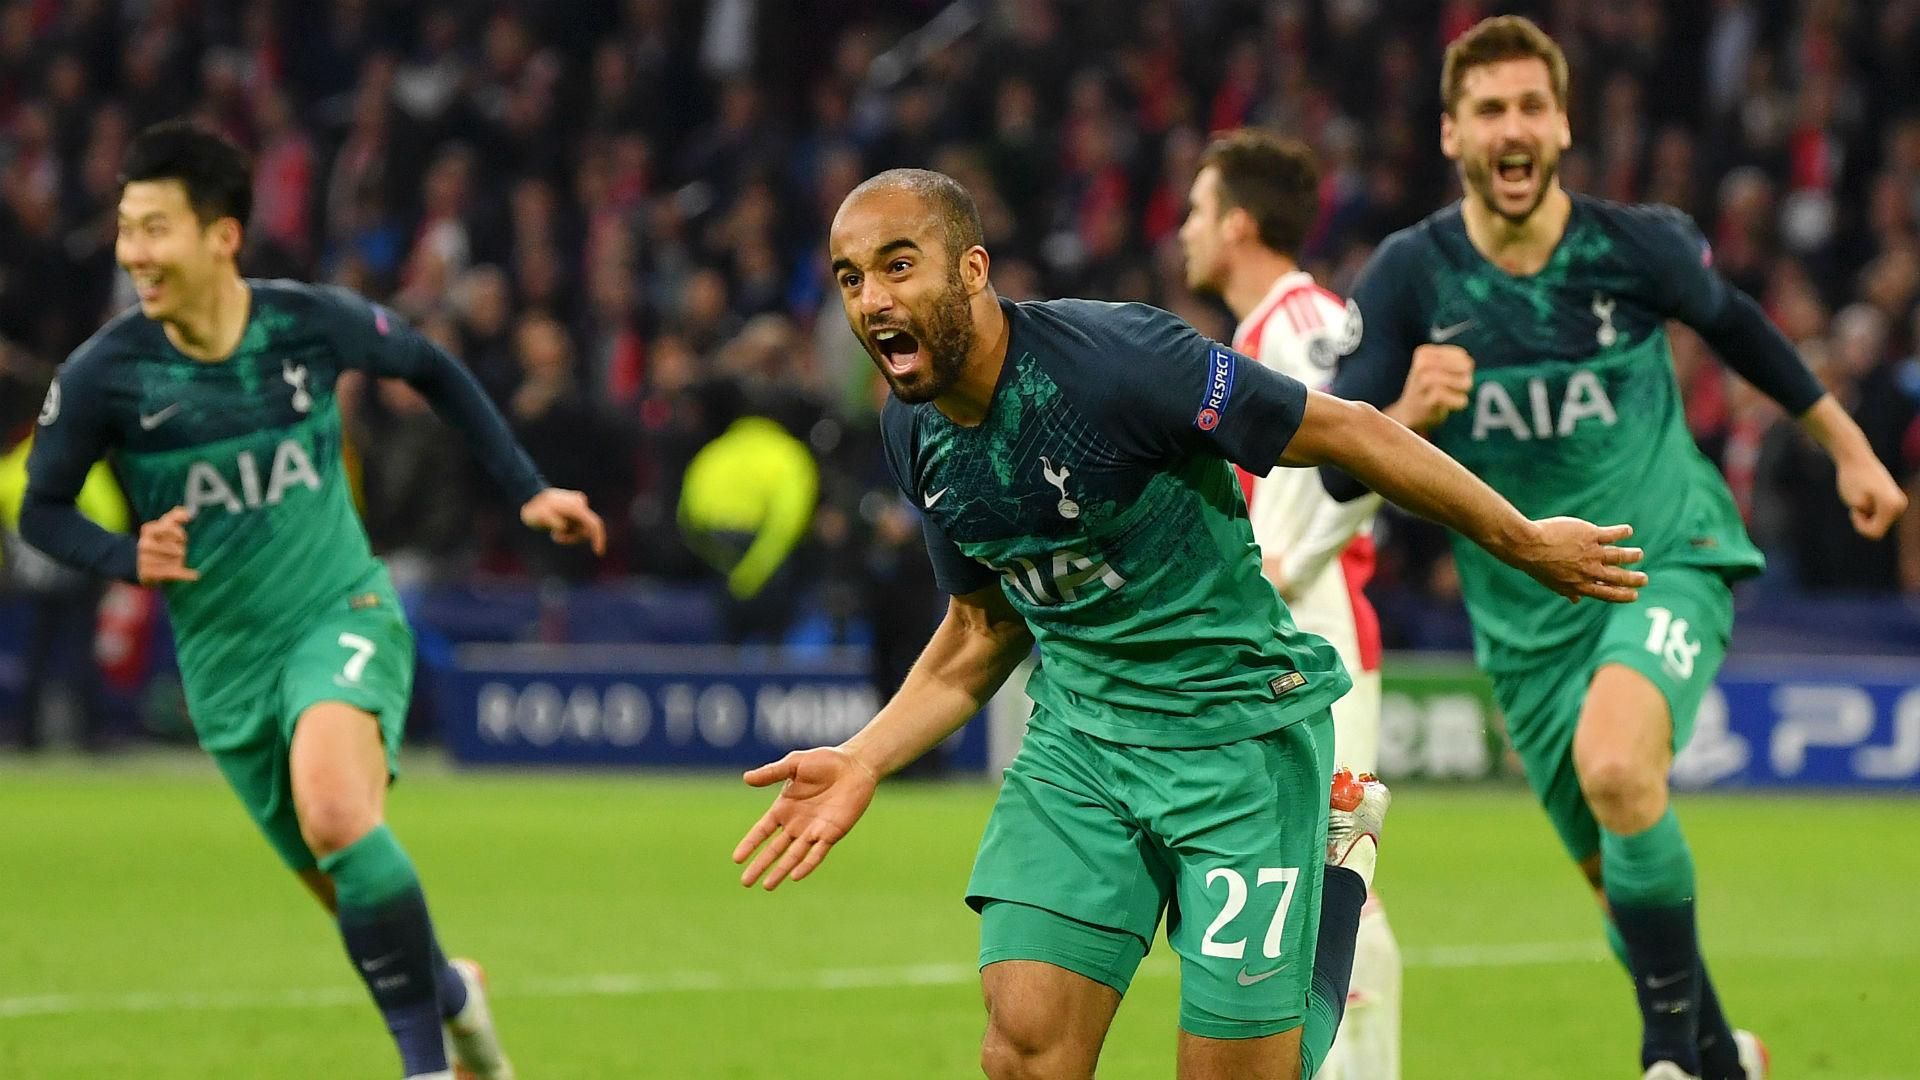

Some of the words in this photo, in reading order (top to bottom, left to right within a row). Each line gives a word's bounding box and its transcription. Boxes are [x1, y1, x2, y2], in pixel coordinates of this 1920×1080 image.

[1209, 351, 1229, 409] RESPECT
[1471, 369, 1618, 441] AIA
[184, 438, 320, 518] AIA
[338, 631, 376, 683] 7
[1645, 606, 1701, 680] 18
[477, 682, 650, 747] ROAD
[658, 682, 748, 748] TO
[1201, 867, 1300, 960] 27
